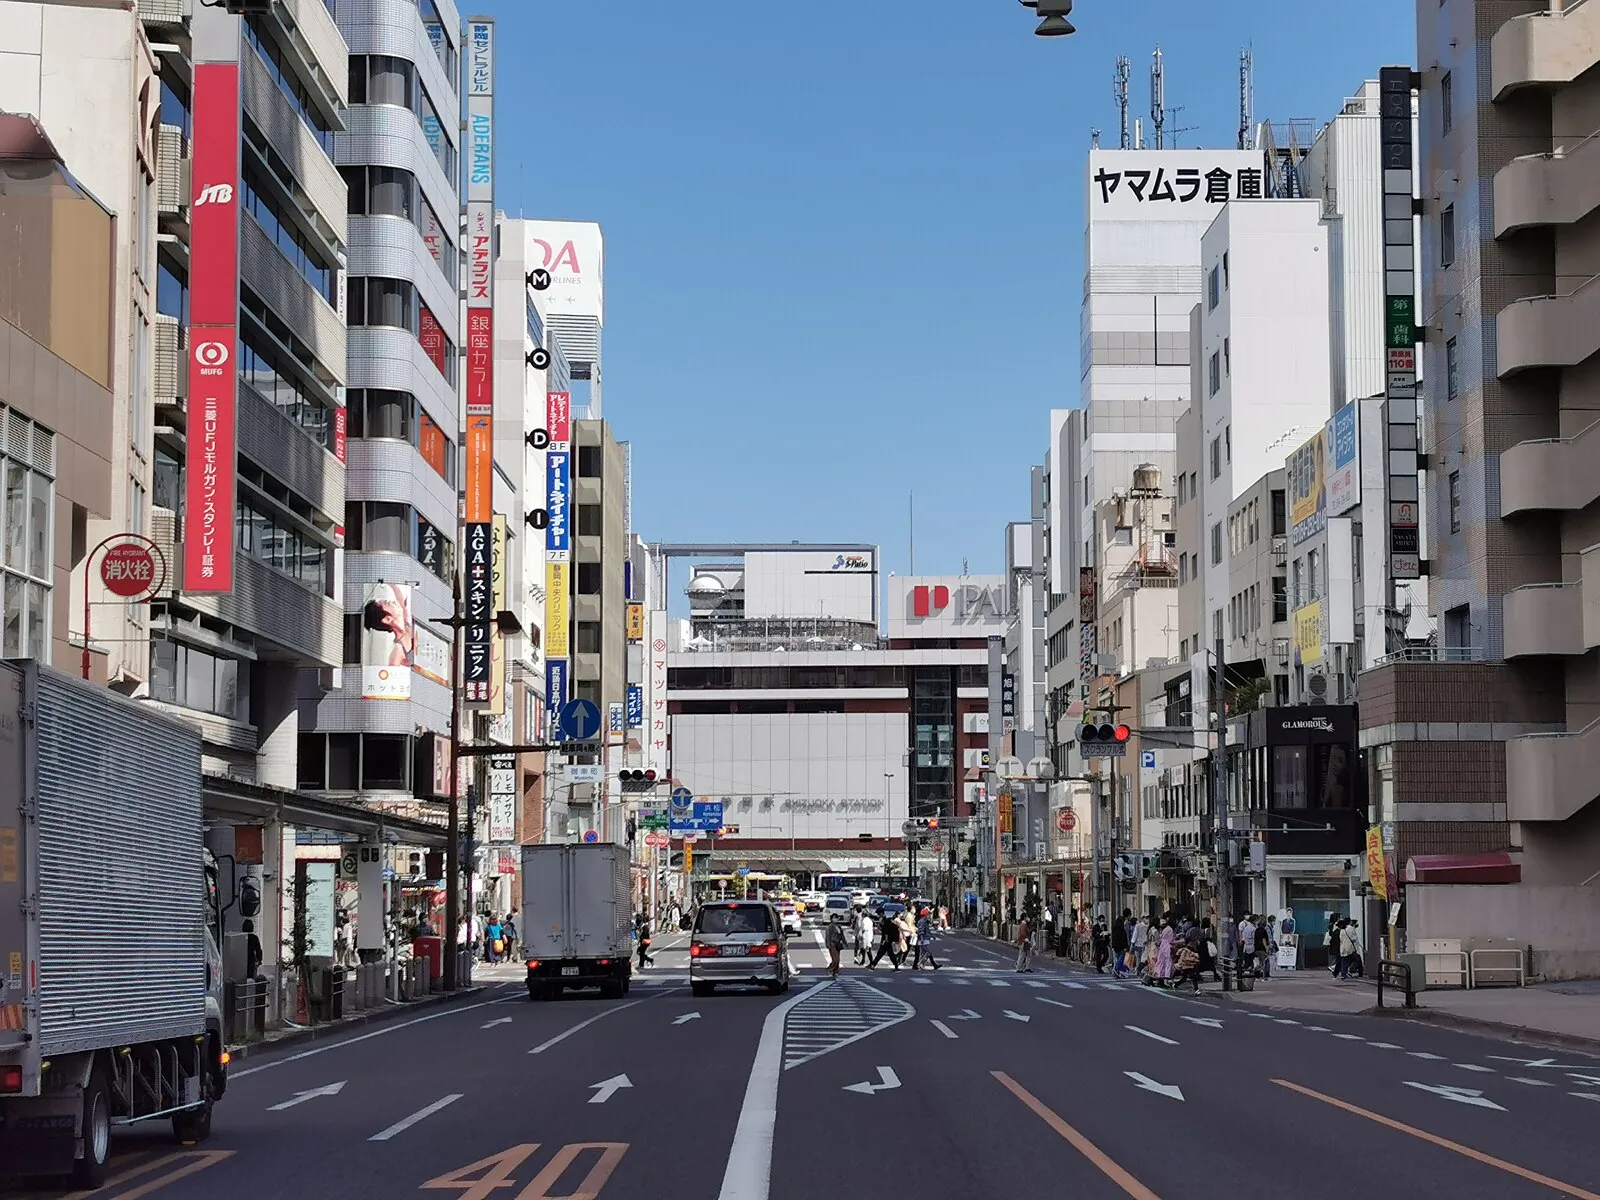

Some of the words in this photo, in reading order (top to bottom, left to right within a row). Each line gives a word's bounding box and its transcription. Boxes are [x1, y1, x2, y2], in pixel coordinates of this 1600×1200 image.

[473, 25, 489, 92] 静岡セントラルビル
[470, 114, 490, 184] ADERANS
[195, 183, 233, 206] JTB
[1093, 166, 1263, 204] ヤマムラ倉庫
[471, 236, 489, 298] アデランス
[532, 272, 547, 286] M
[471, 315, 489, 397] 銀座カラー
[533, 351, 546, 366] O
[200, 368, 223, 376] MUFG
[534, 432, 546, 446] D
[201, 397, 217, 578] 三菱UFJモルガン・スタンレー証券
[550, 456, 565, 547] アートネイチャー
[472, 524, 486, 564] AGA
[105, 559, 151, 581] 消火栓
[629, 716, 641, 724] 4F
[1282, 720, 1328, 729] GLAMOROUS
[1142, 752, 1154, 767] P
[417, 1142, 631, 1200] 40
